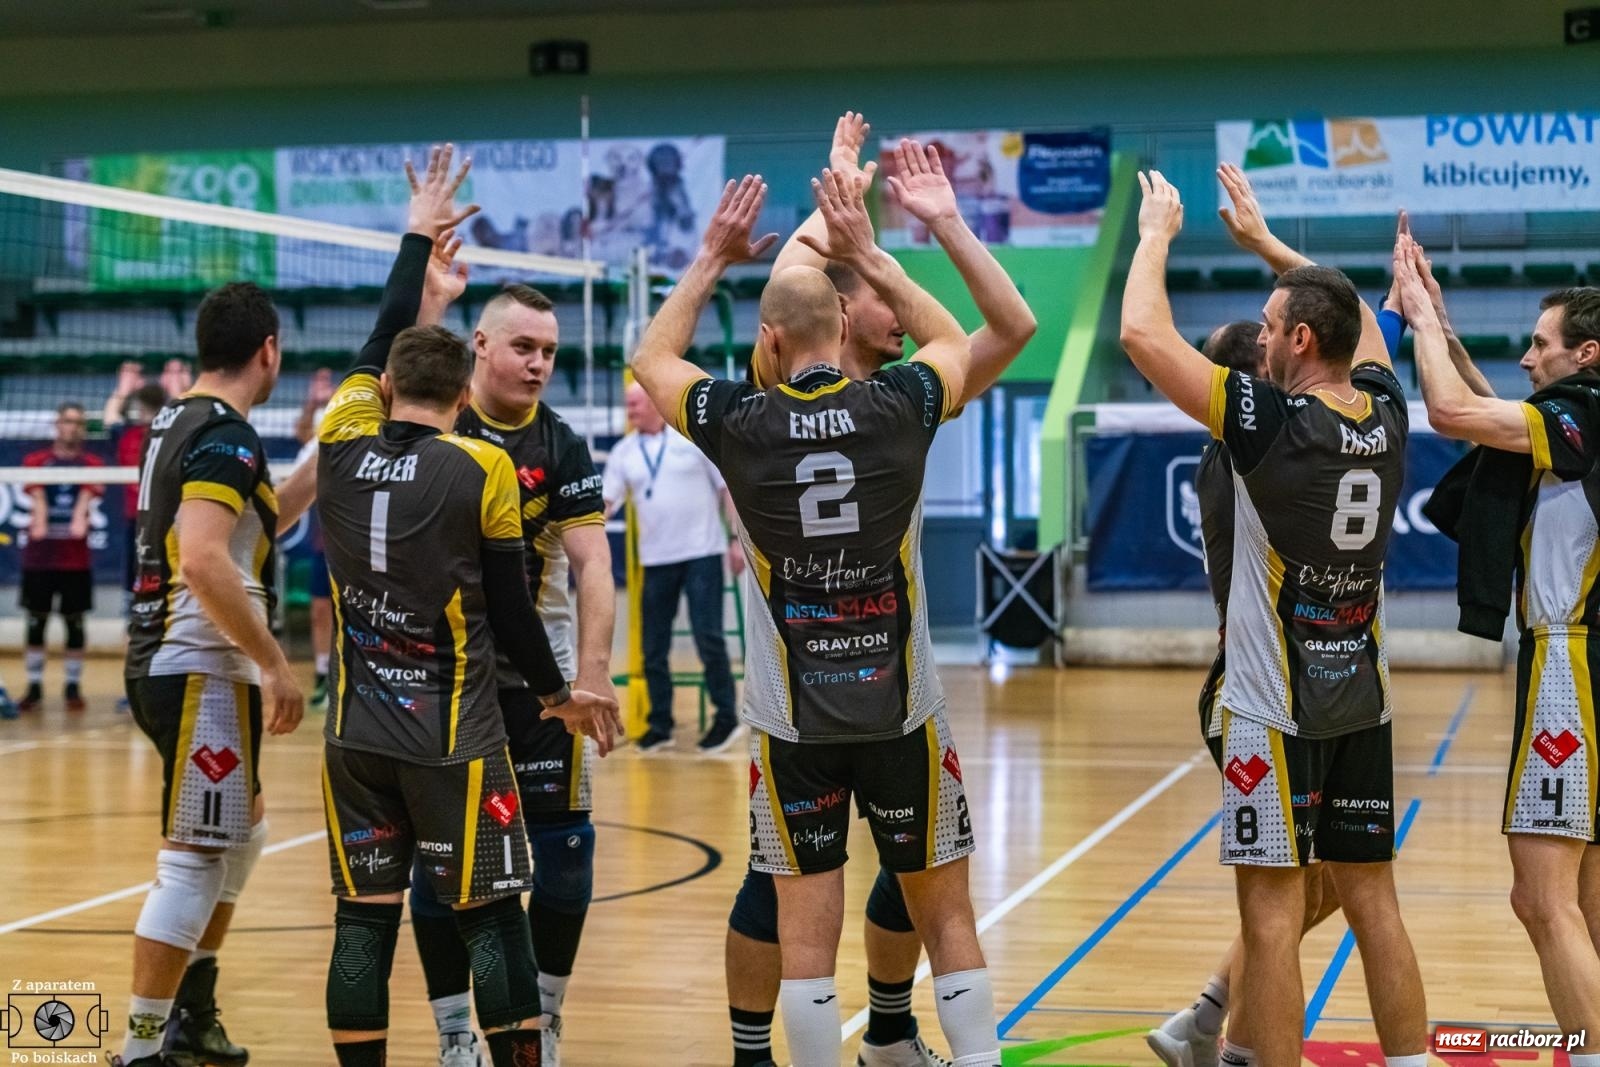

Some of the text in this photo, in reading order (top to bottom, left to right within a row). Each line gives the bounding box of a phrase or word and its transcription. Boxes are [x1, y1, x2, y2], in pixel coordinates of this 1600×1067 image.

[1426, 111, 1600, 148] POWIAT
[164, 163, 260, 202] ZOO
[1423, 161, 1590, 190] kibicujemy,
[789, 408, 857, 440] ENTER
[355, 451, 419, 482] ENTER
[795, 451, 860, 538] 2
[1330, 469, 1382, 551] 8
[370, 491, 391, 573] 1
[819, 548, 877, 593] Hair
[806, 632, 889, 653] GRAVTON
[802, 669, 857, 686] GTrans
[1540, 735, 1563, 758] Enter
[1231, 762, 1253, 786] Enter
[1332, 799, 1390, 811] GRAVTON
[1541, 778, 1564, 816] 4
[1236, 805, 1259, 845] 8
